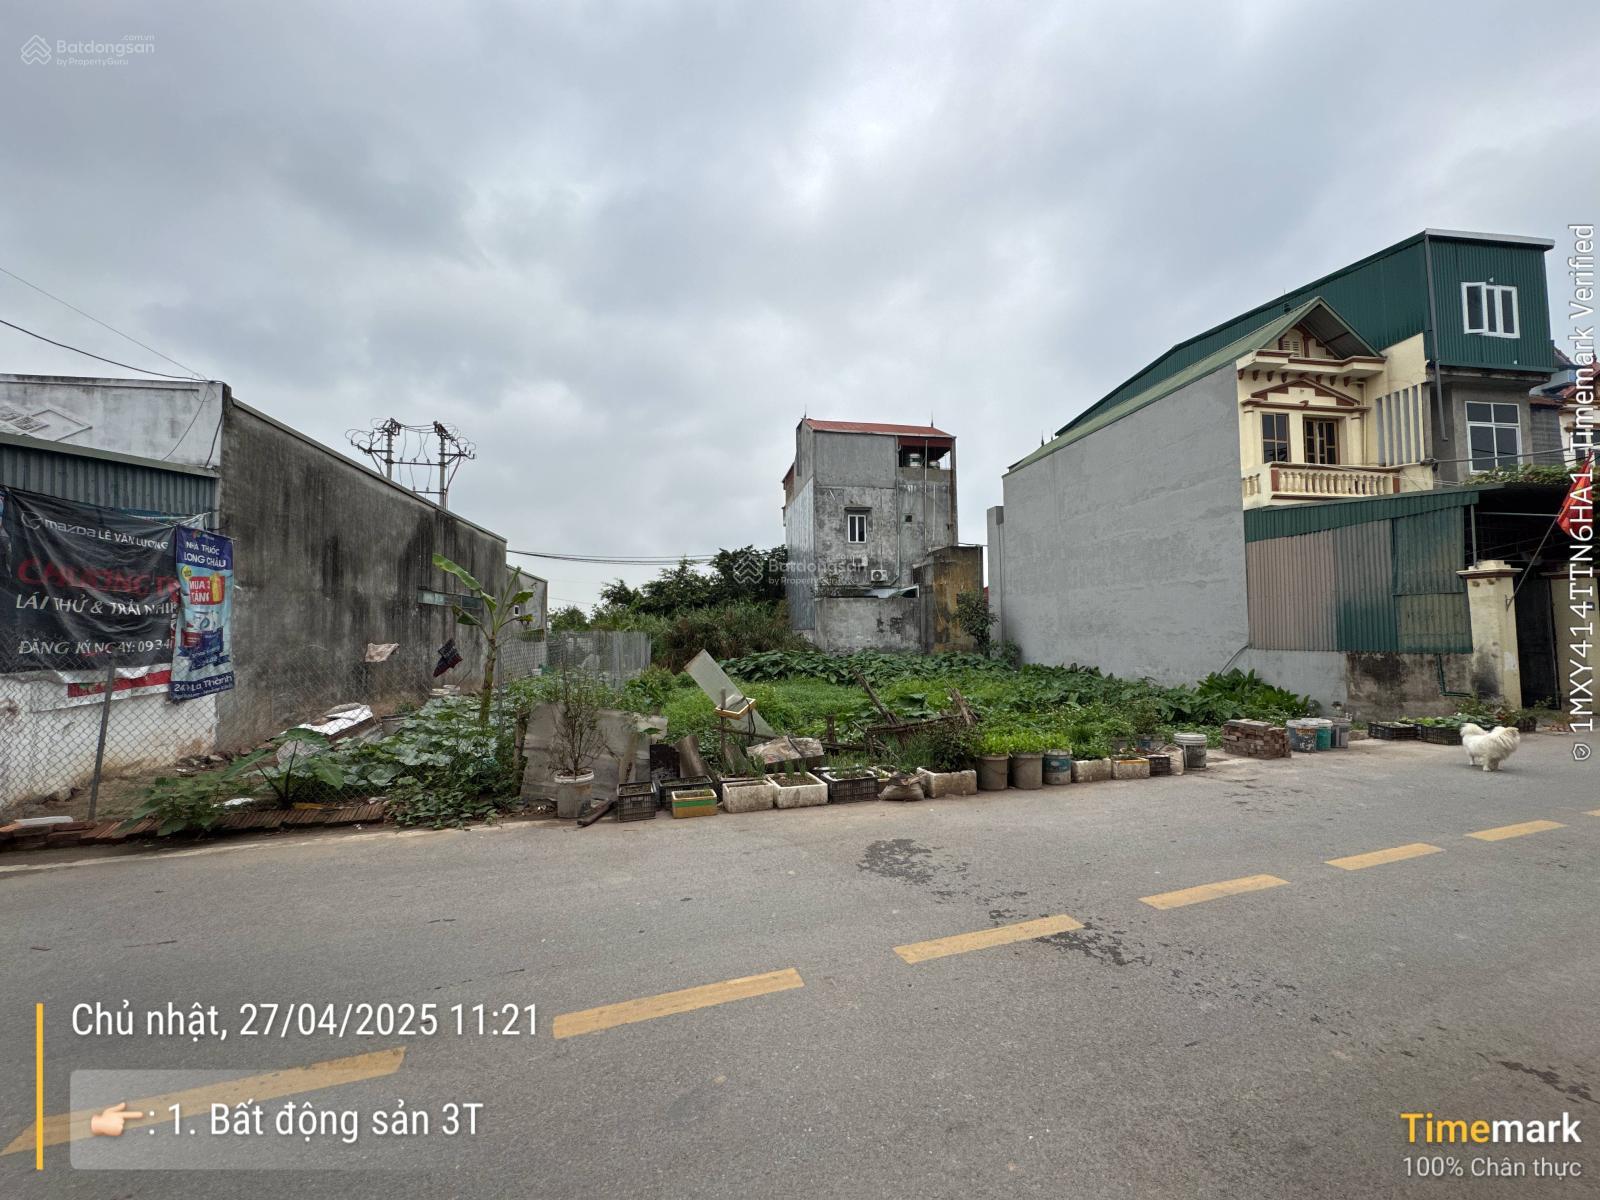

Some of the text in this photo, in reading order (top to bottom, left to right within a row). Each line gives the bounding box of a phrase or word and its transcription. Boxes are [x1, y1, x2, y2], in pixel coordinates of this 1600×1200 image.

[98, 529, 112, 541] LÊ
[184, 552, 206, 564] LONG
[16, 591, 49, 610] LÁI
[53, 594, 89, 613] THỬ
[90, 601, 103, 614] &
[18, 638, 70, 654] ĐĂNG
